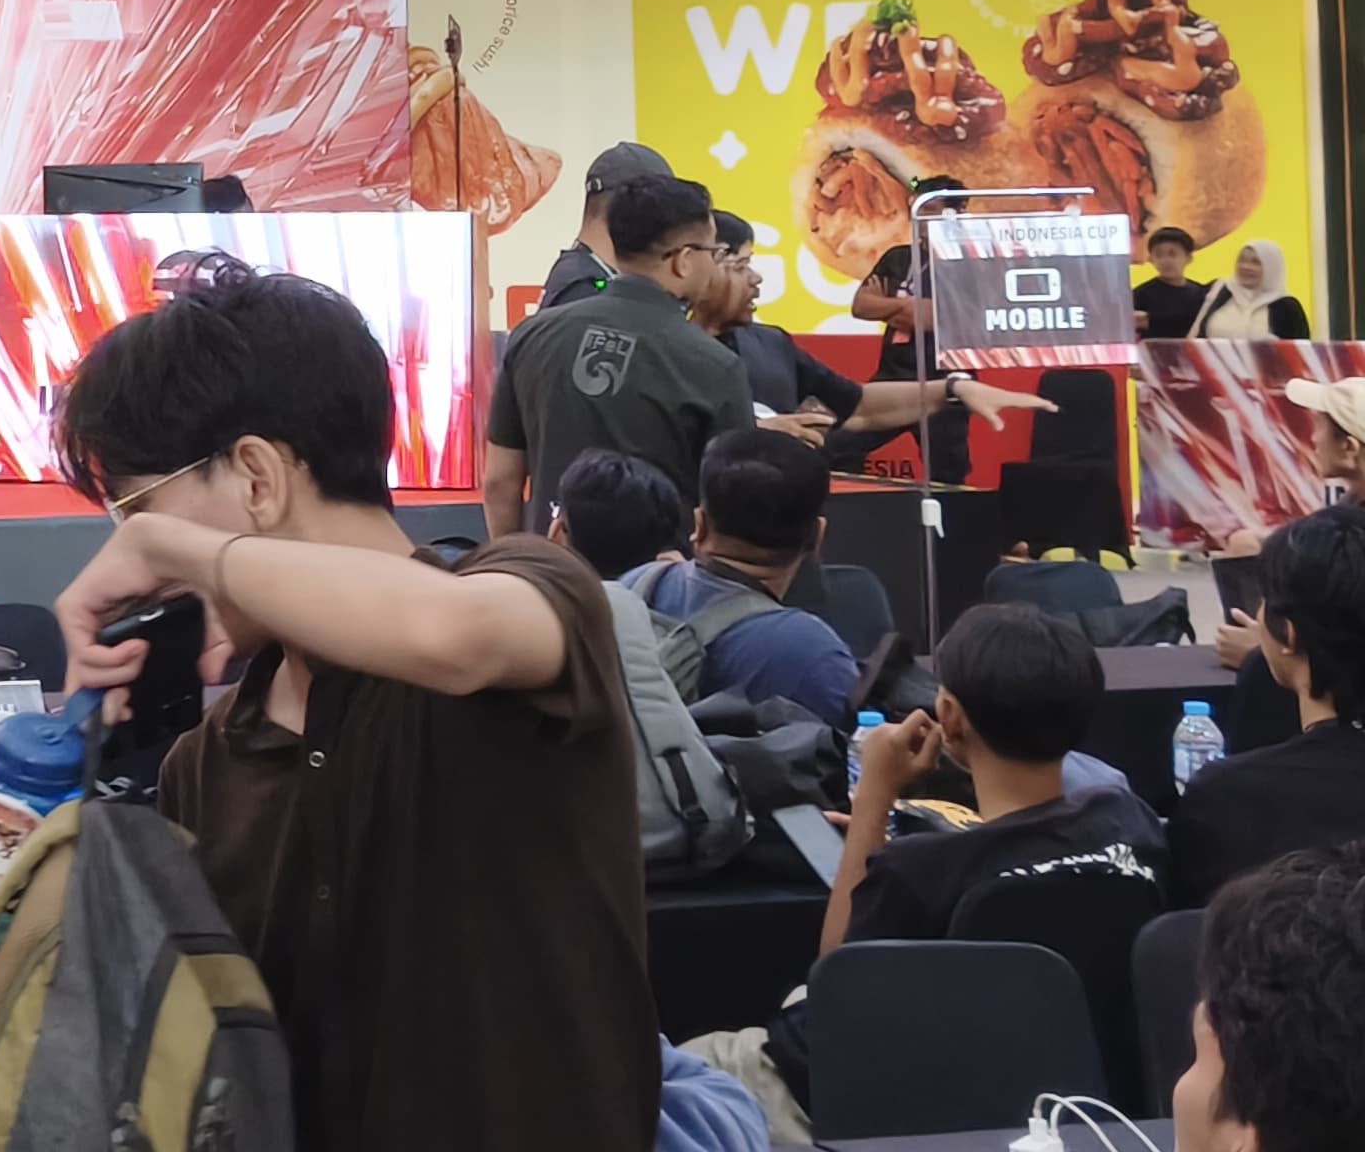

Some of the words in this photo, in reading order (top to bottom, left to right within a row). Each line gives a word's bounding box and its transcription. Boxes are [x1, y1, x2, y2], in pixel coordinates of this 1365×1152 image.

[472, 36, 505, 74] sushi
[999, 226, 1082, 241] INDONESIA
[1088, 225, 1117, 239] CUP
[985, 306, 1086, 331] MOBILE
